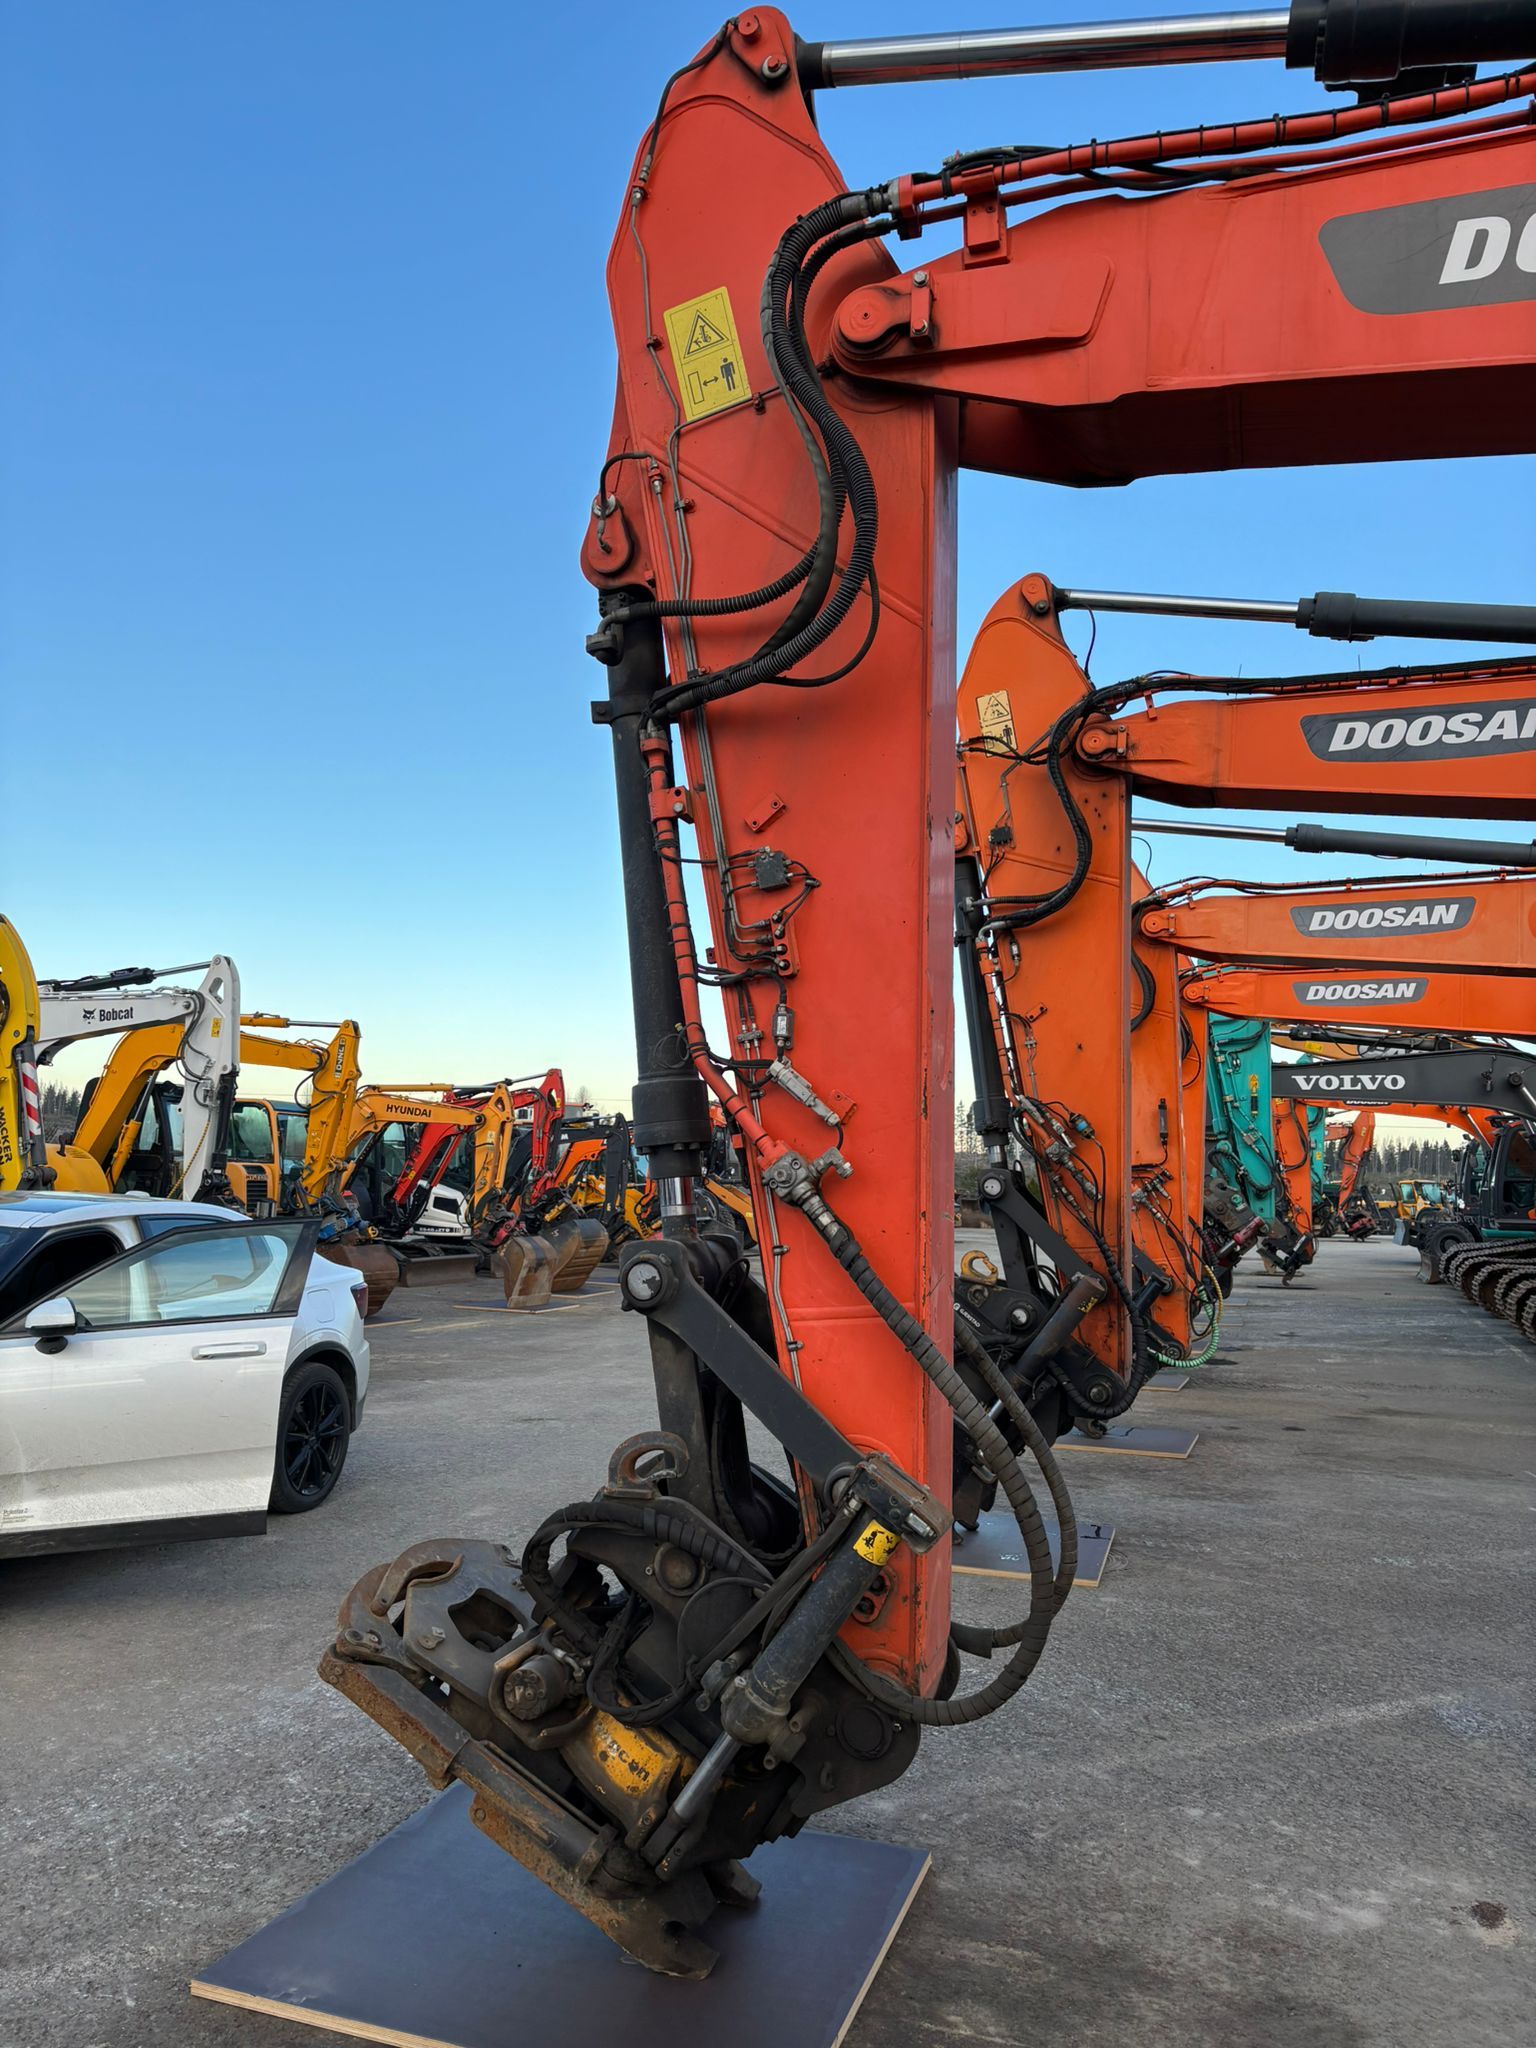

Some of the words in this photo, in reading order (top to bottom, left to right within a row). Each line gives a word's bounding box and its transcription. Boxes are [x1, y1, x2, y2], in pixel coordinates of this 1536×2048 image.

[1308, 903, 1460, 931] DOOSAN
[1306, 982, 1417, 1001] DOOSAN
[98, 1006, 134, 1022] Bobcat
[1291, 1074, 1406, 1091] VOLVO
[385, 1103, 432, 1118] HYUNDAI
